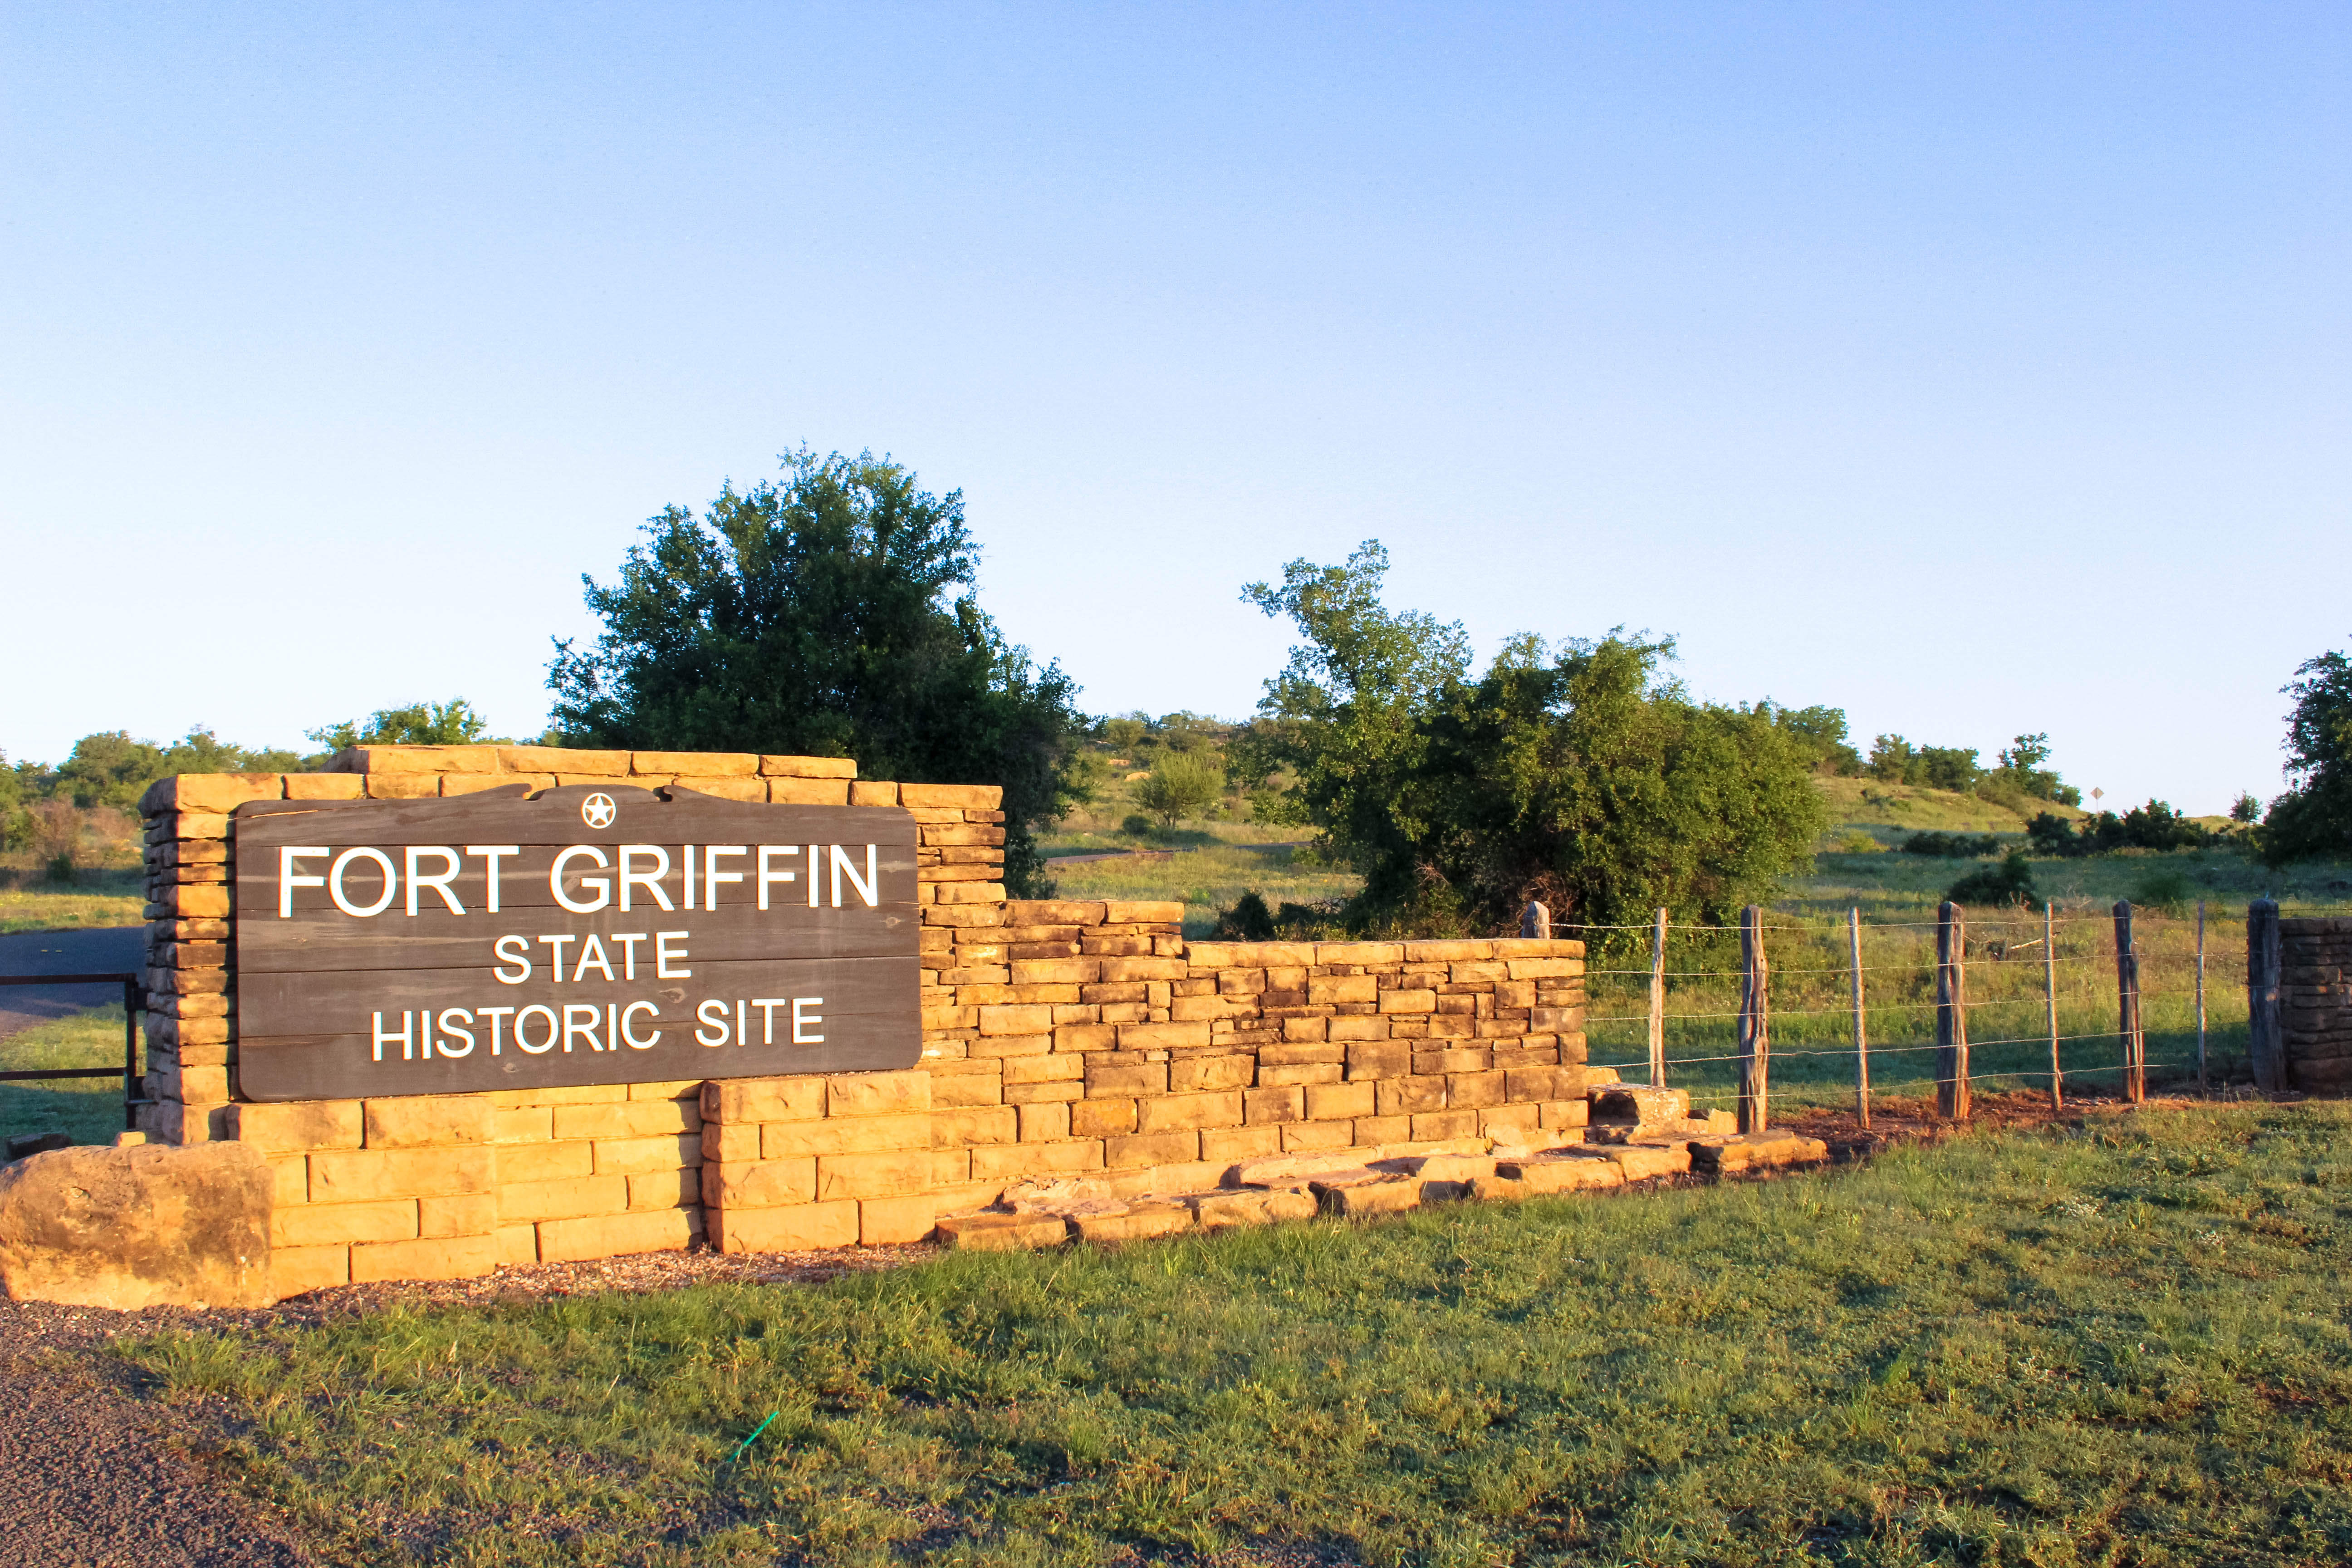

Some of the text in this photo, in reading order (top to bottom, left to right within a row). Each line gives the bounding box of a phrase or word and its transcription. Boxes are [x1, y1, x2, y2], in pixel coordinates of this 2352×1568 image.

[279, 843, 879, 919] FORT GRIFFIN
[492, 930, 692, 985] STATE
[372, 996, 826, 1061] HISTORIC SITE
